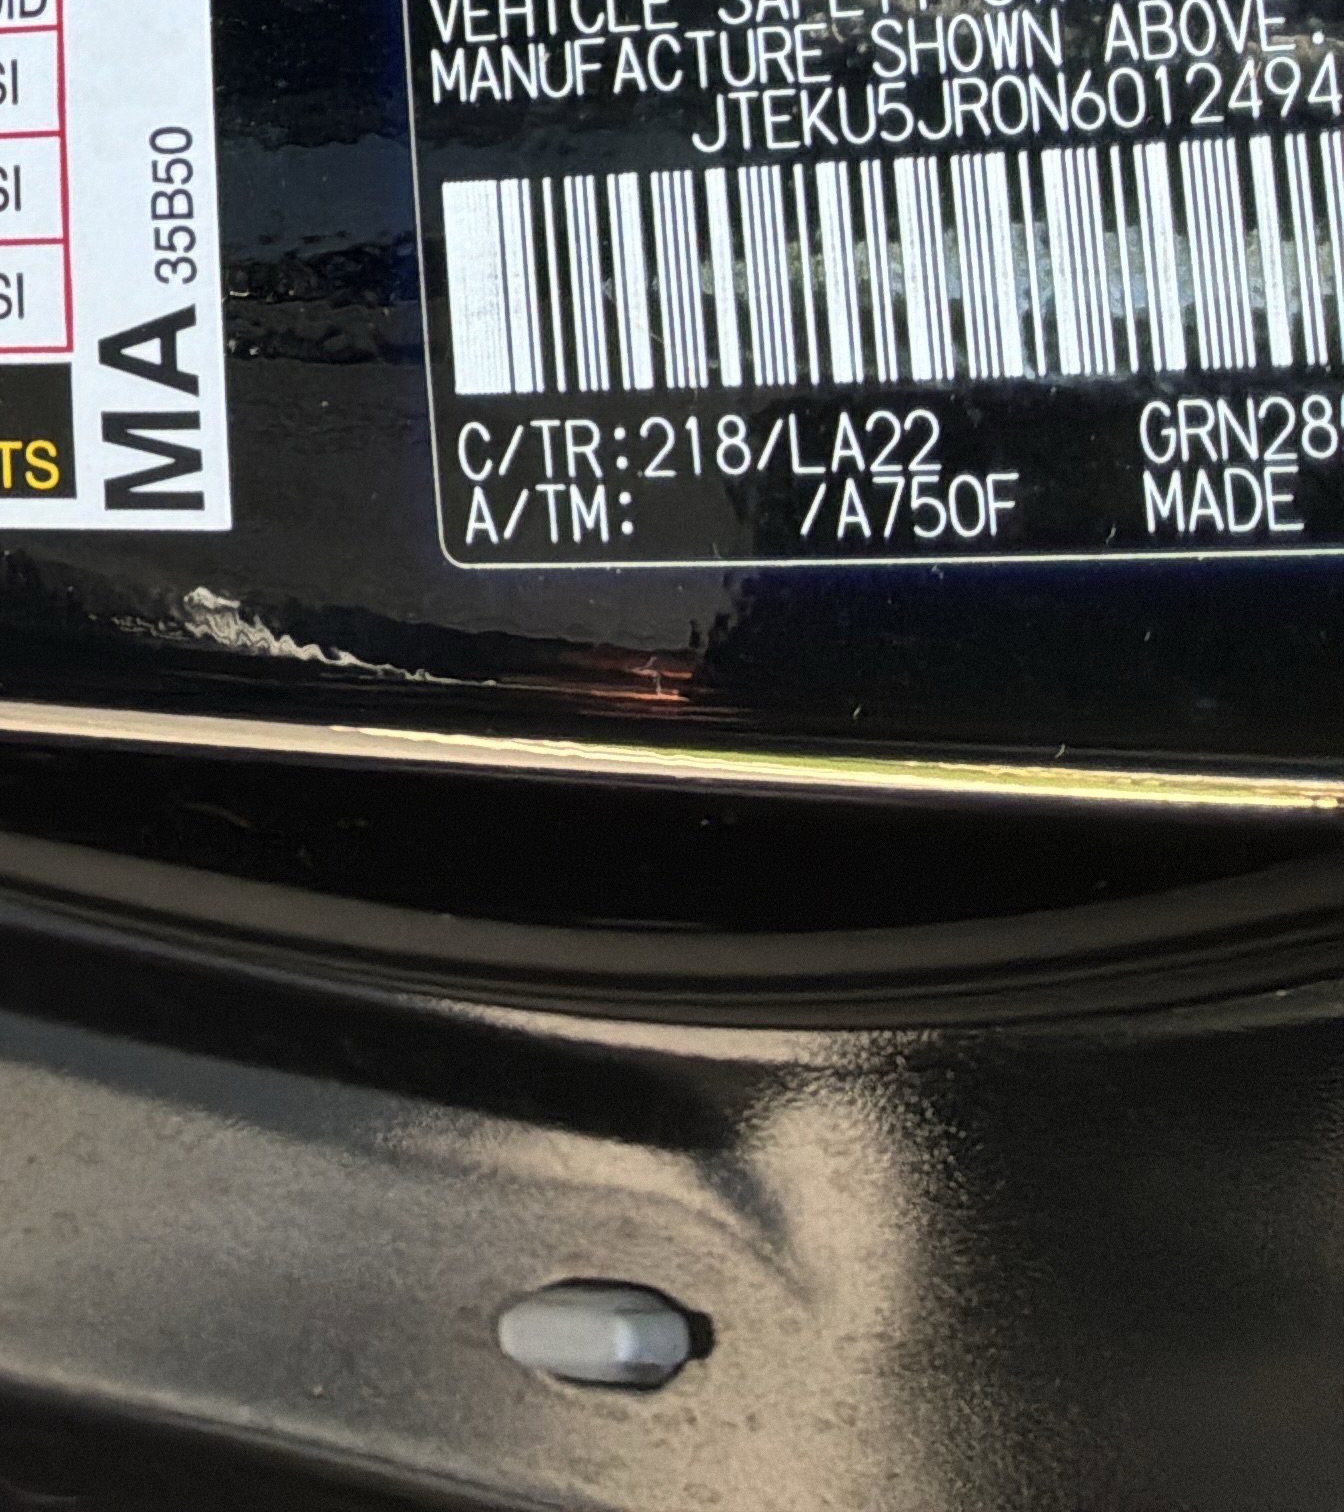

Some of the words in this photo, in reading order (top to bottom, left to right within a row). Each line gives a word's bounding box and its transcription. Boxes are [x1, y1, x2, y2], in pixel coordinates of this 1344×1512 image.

[430, 22, 832, 104] MANUFACTURE
[871, 7, 1063, 78] SHOWN
[148, 126, 198, 285] 35B50
[97, 303, 206, 511] MA
[458, 408, 942, 482] C/TR:218/LA22
[465, 483, 634, 544] A/TM:
[800, 472, 1020, 538] /A750F
[1142, 465, 1305, 533] MADE
